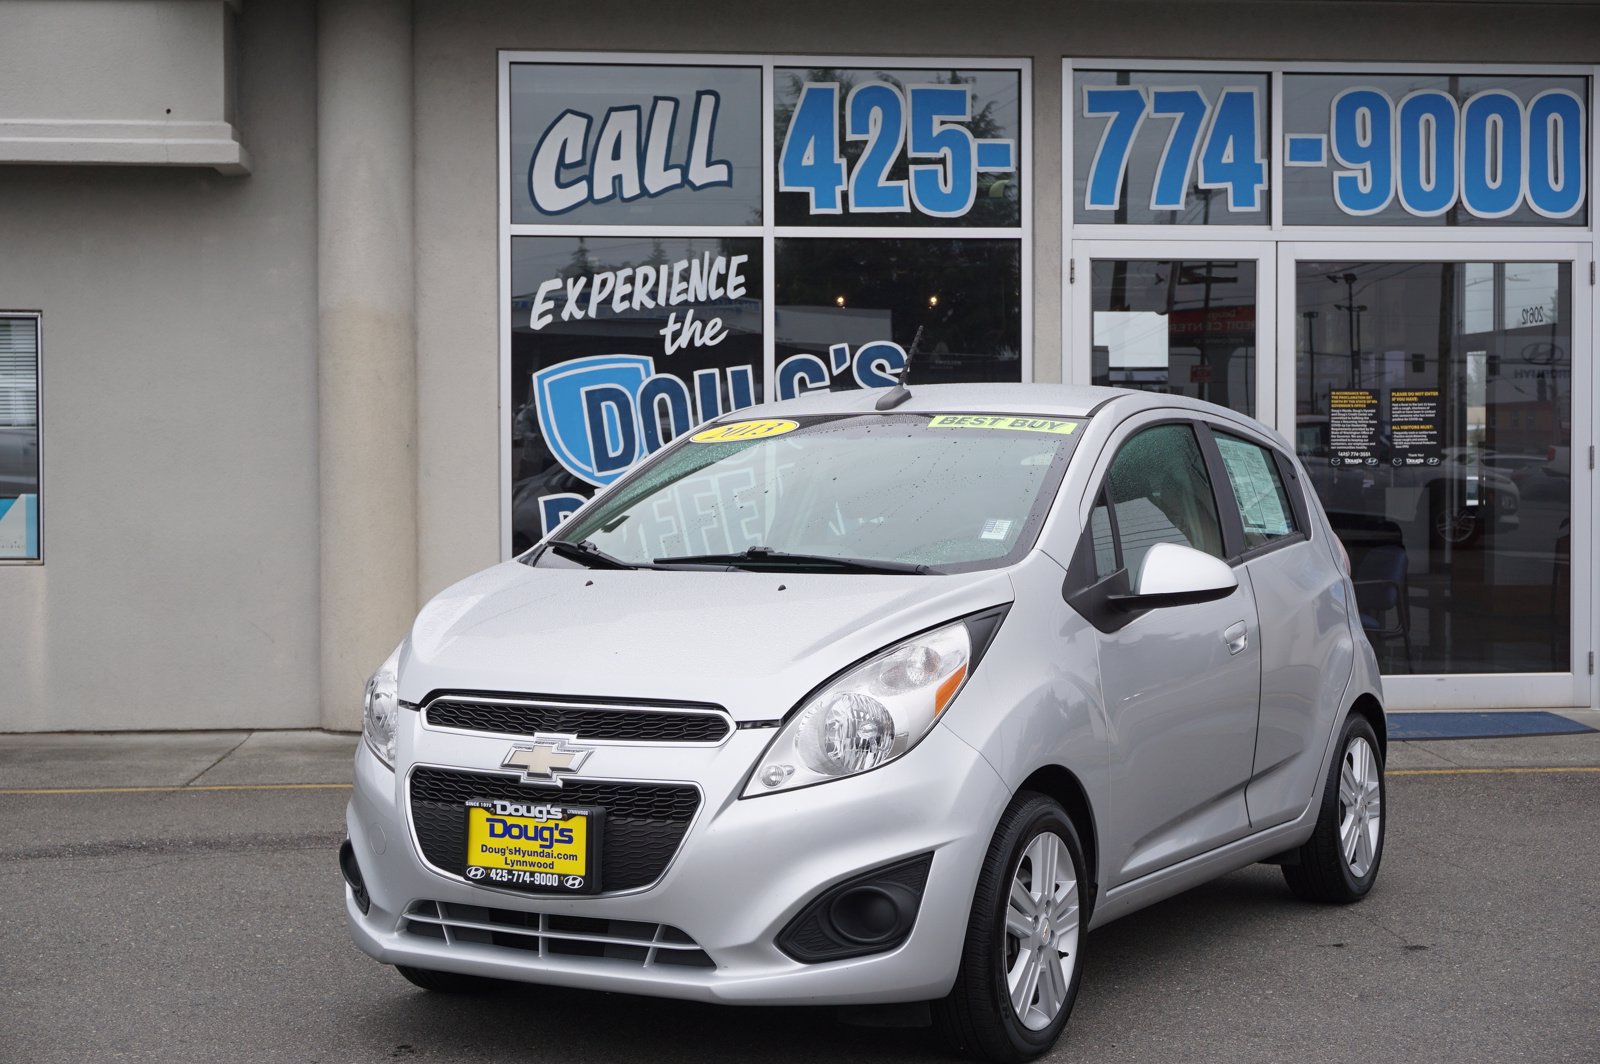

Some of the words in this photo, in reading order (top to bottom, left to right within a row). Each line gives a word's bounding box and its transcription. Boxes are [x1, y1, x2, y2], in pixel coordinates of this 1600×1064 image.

[528, 90, 733, 216] CALL
[778, 82, 1016, 218] 425-
[530, 254, 748, 331] EXPERIENCE
[659, 309, 728, 356] the
[937, 416, 1008, 426] BEST
[1008, 418, 1066, 430] BUY
[494, 800, 562, 822] Doug's
[486, 818, 574, 849] Doug's
[481, 844, 578, 861] Doug'sHyundai.com
[504, 857, 554, 869] Lynnwood
[490, 869, 558, 886] 425-774-9000
